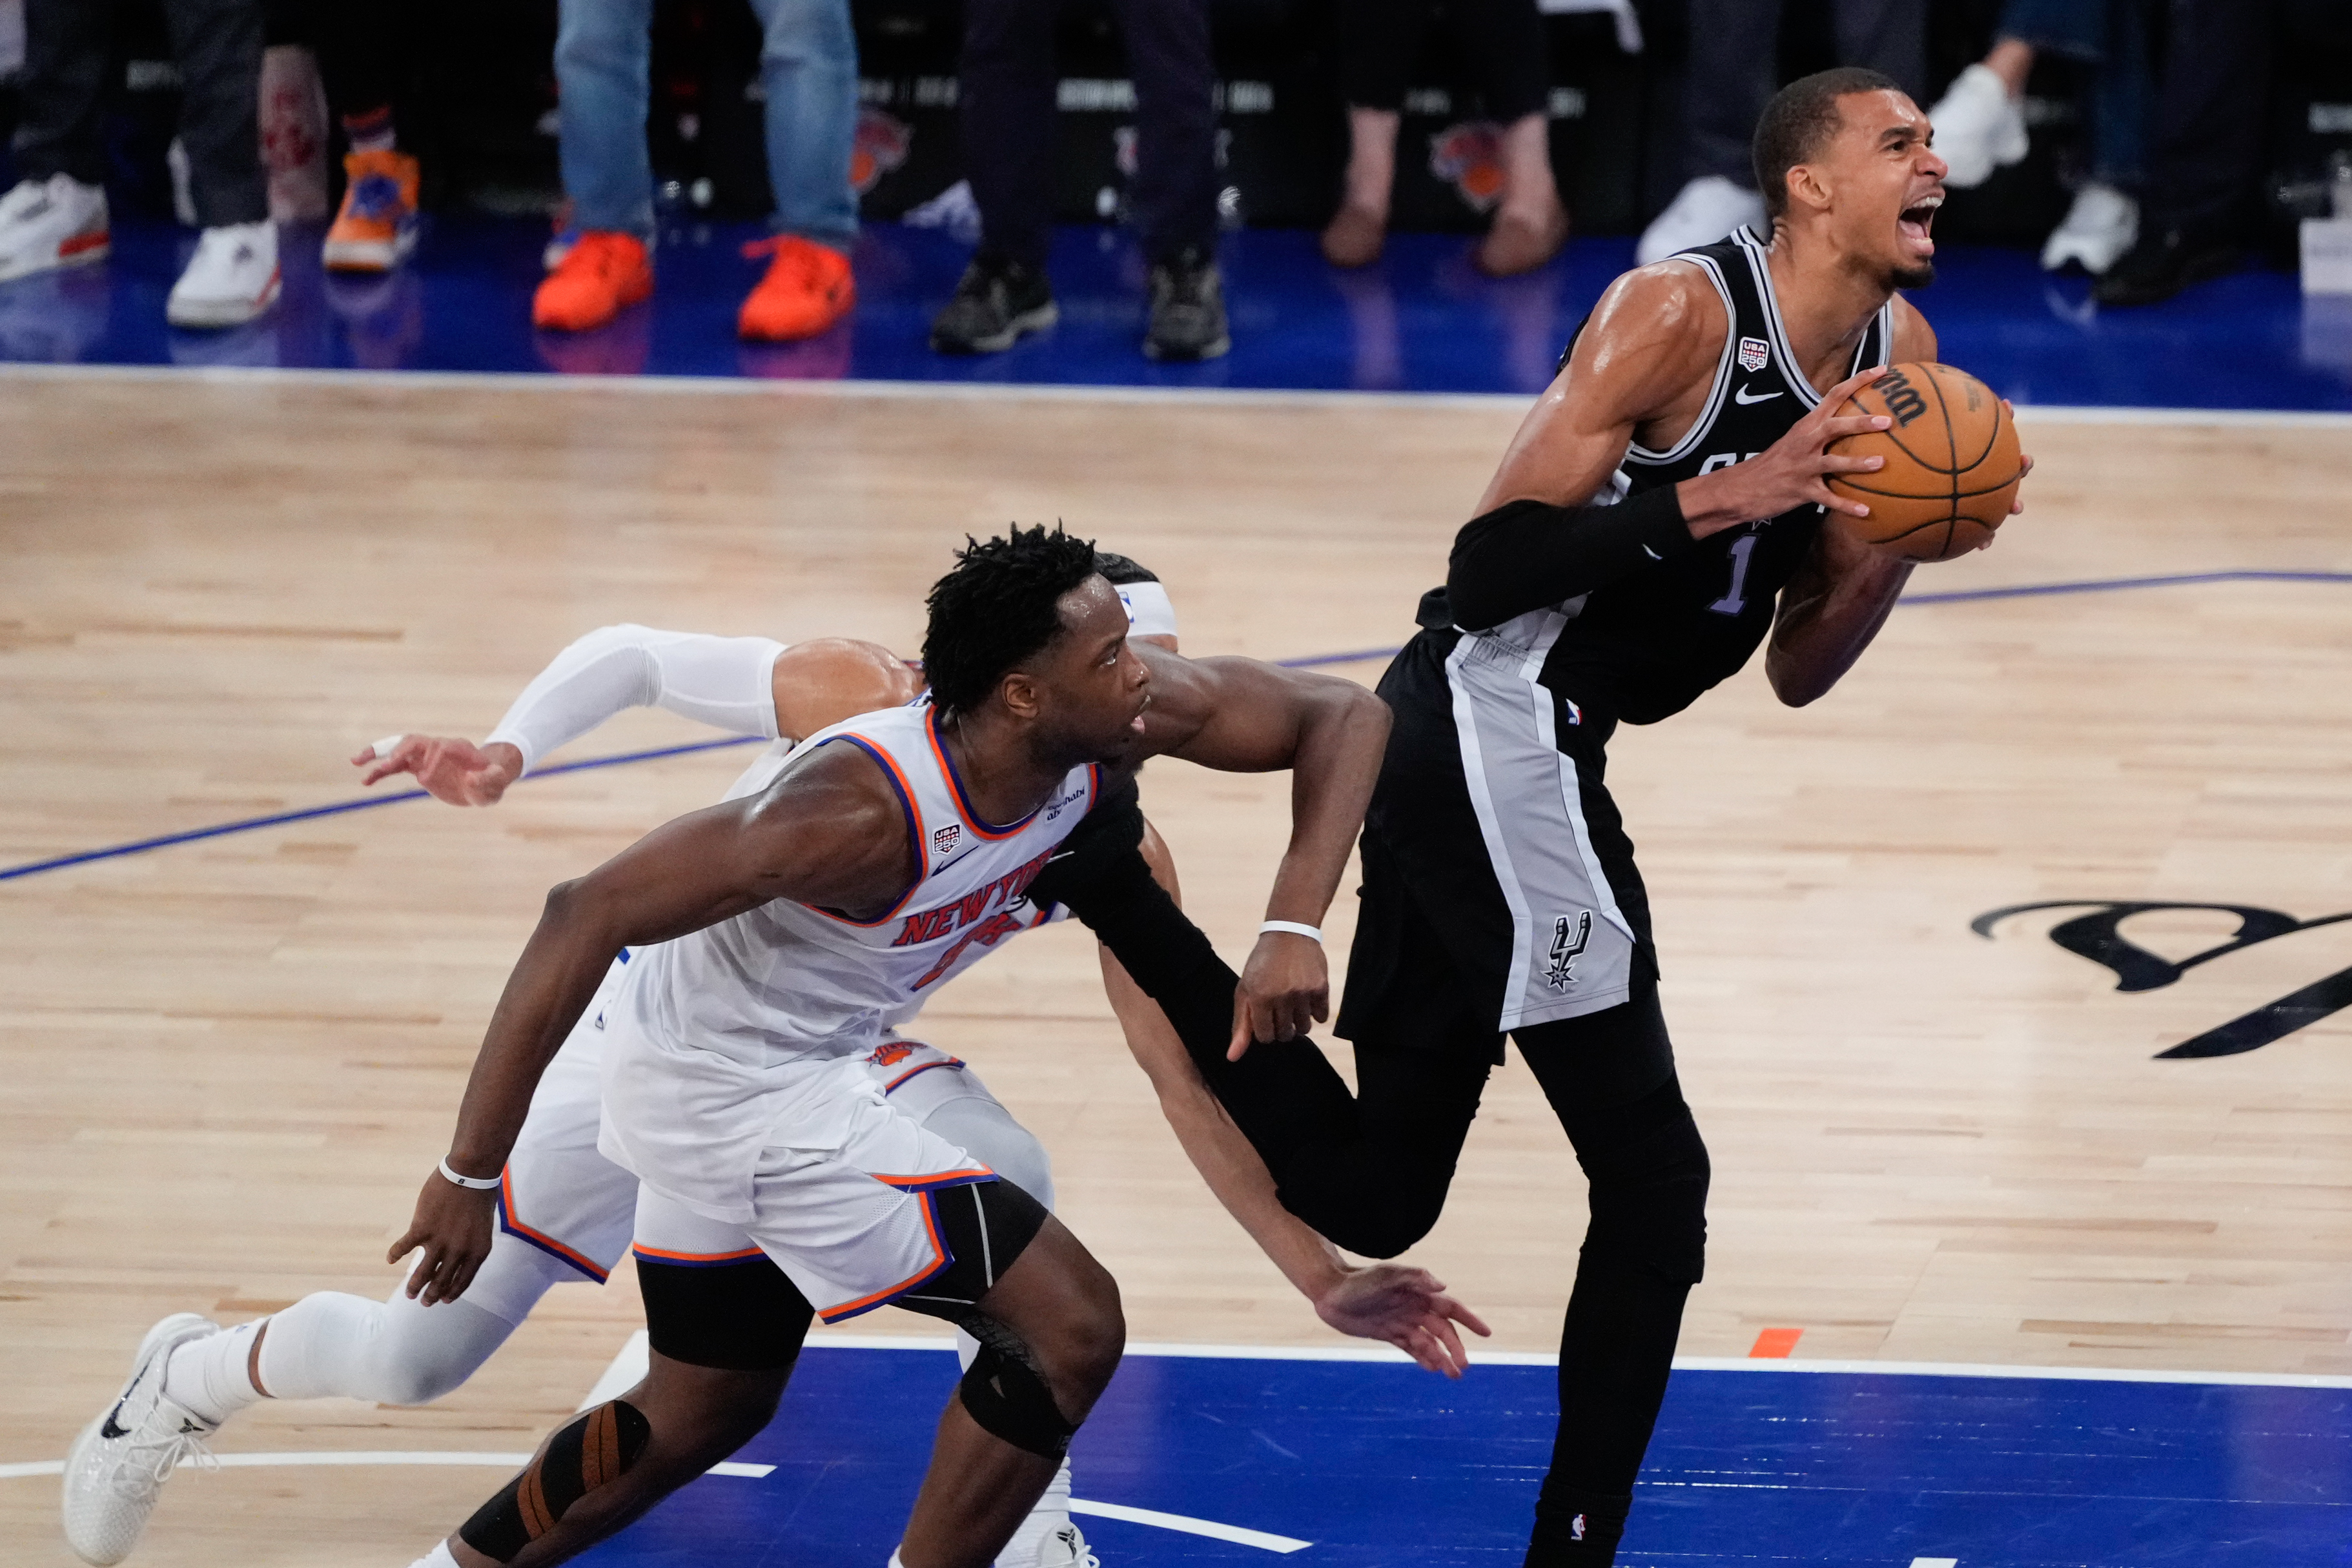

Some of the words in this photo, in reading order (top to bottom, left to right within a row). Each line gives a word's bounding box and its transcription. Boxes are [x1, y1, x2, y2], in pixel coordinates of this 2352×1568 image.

[1744, 341, 1765, 352] USA
[1742, 354, 1764, 365] 250
[1705, 532, 1761, 616] 1
[936, 827, 959, 839] USA
[935, 837, 960, 851] 250
[890, 882, 998, 948] NEW
